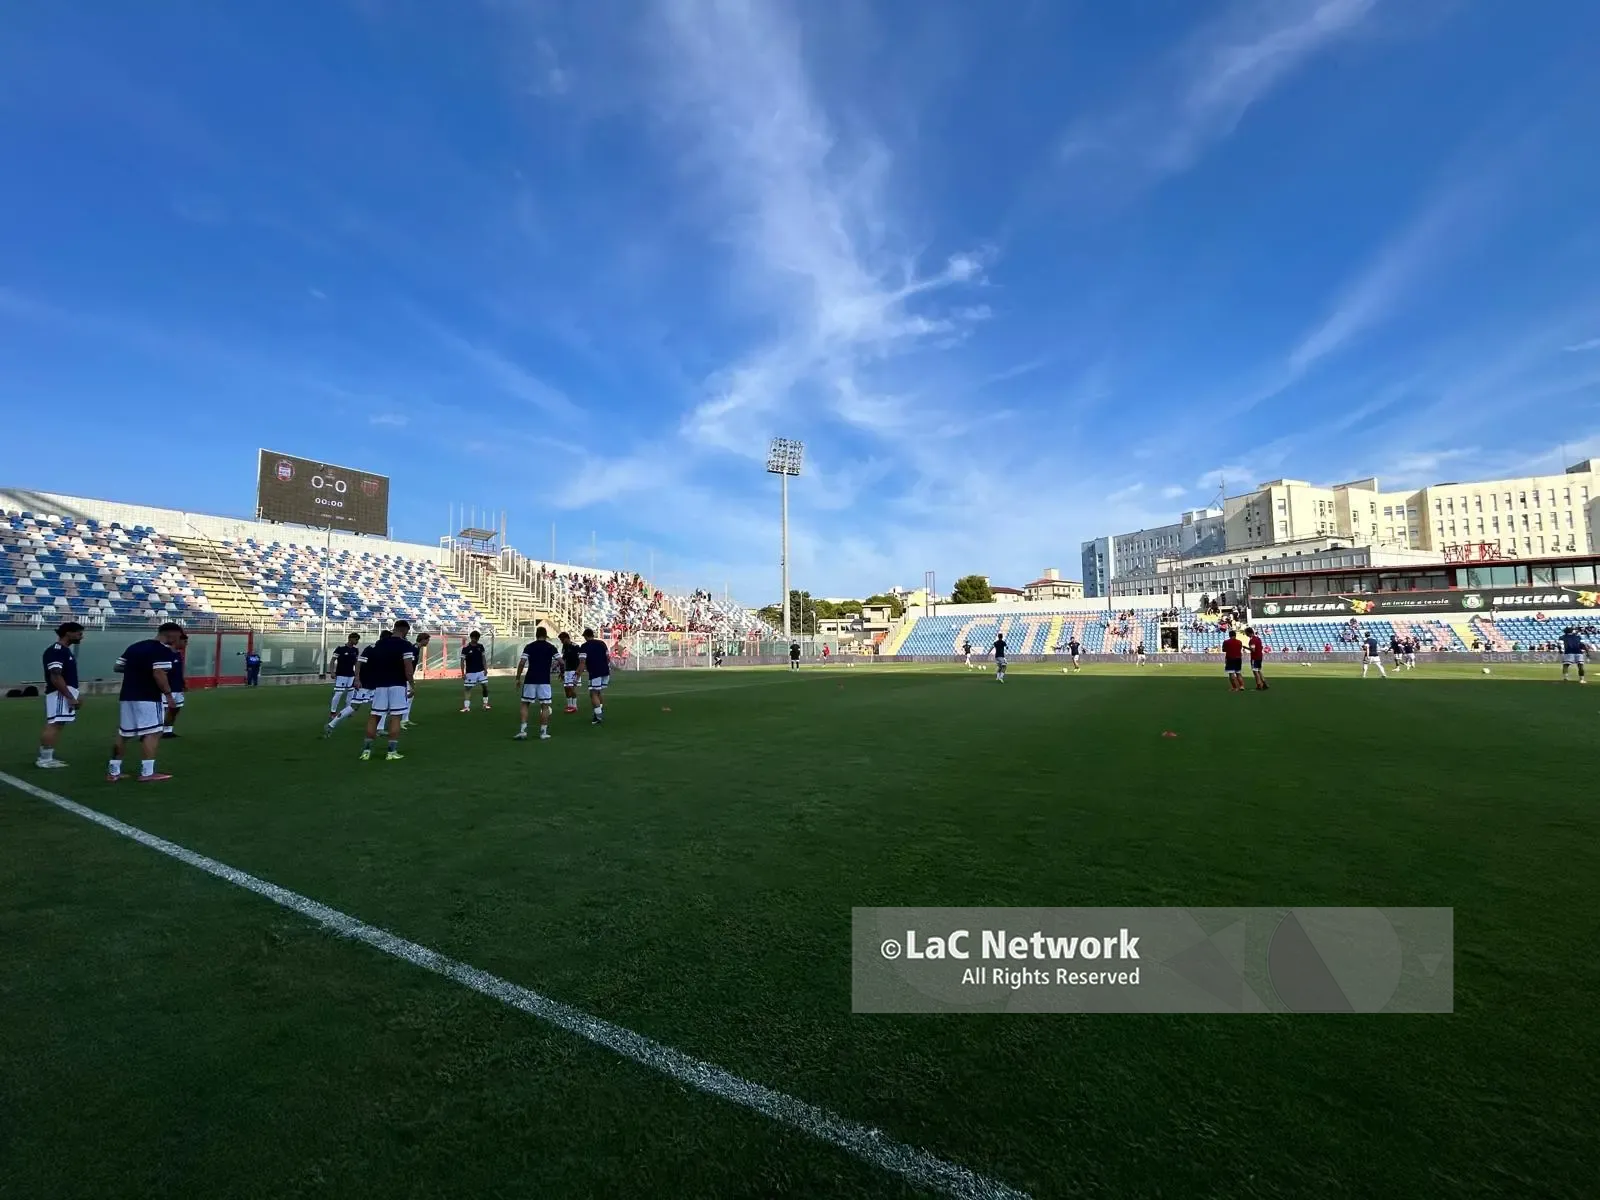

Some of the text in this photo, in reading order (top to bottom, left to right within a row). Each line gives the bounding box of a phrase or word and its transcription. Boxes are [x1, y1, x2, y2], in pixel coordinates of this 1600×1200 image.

[315, 497, 343, 507] 00:00
[1492, 594, 1570, 605] BUSCEMA
[1284, 603, 1345, 612] BUSCEMA
[1482, 653, 1559, 662] SERIE C SKY
